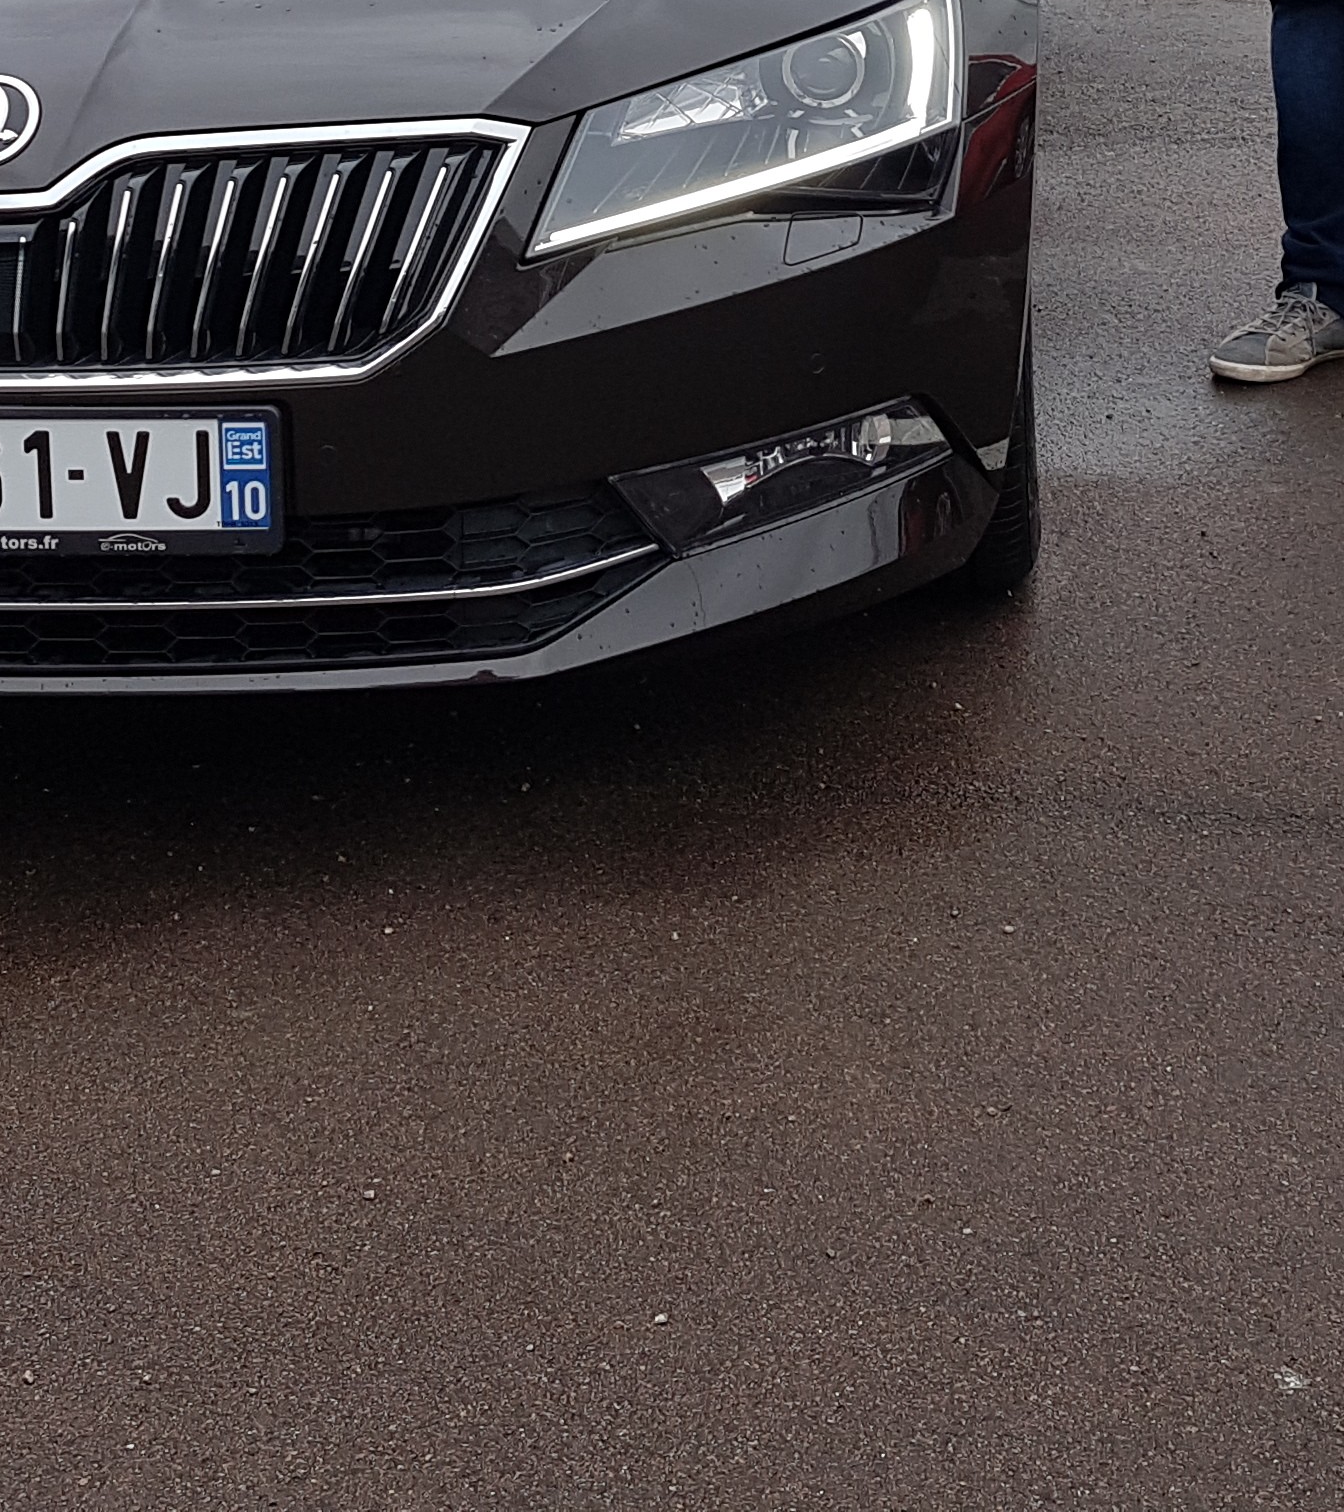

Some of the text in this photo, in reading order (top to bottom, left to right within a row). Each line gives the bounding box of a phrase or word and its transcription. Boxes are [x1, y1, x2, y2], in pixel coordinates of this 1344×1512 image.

[226, 430, 262, 441] Grand
[226, 441, 262, 460] Est
[225, 480, 266, 521] 10
